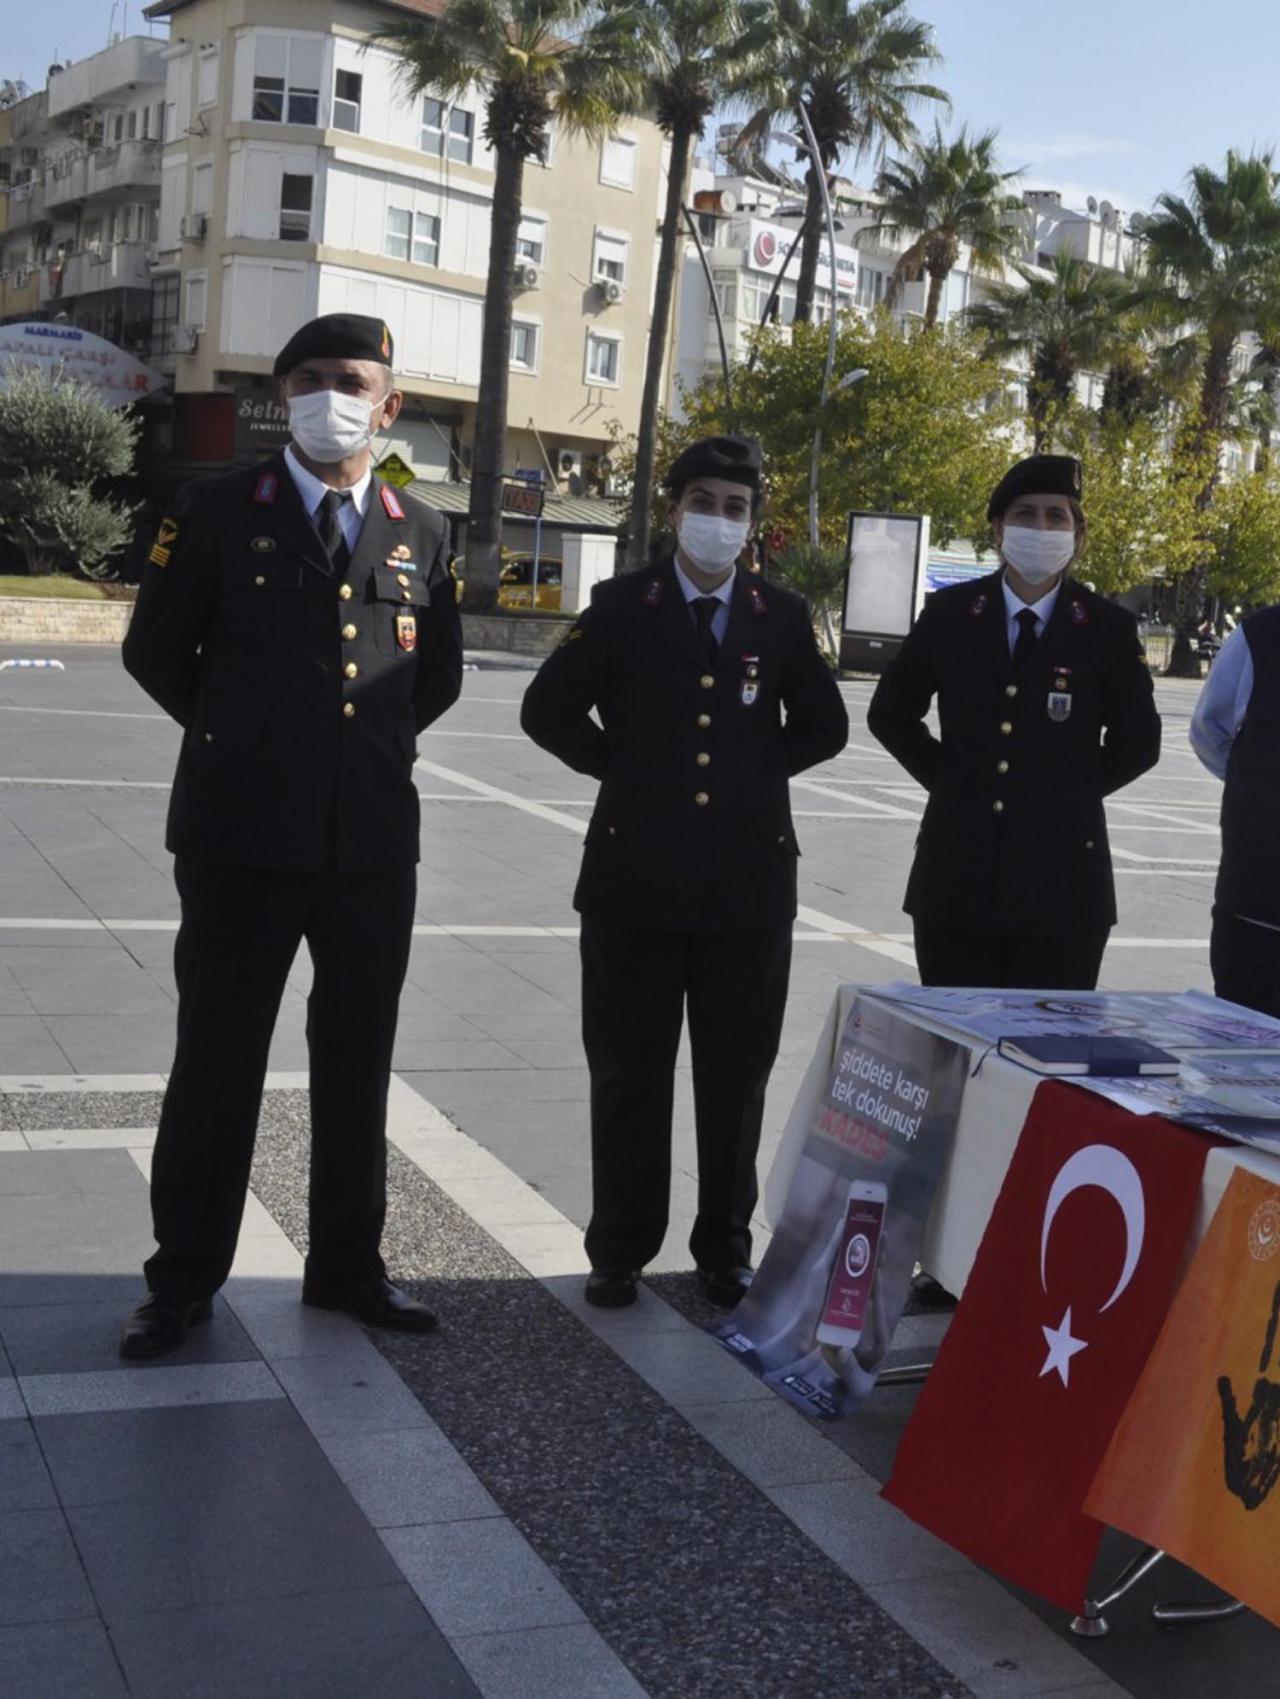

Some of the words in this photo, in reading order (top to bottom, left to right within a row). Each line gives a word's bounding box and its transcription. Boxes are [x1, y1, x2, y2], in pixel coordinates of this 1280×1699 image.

[831, 1075, 855, 1107] tek
[855, 1090, 921, 1141] dokunuş!
[840, 1049, 893, 1090] şiddete
[894, 1070, 929, 1111] karşı
